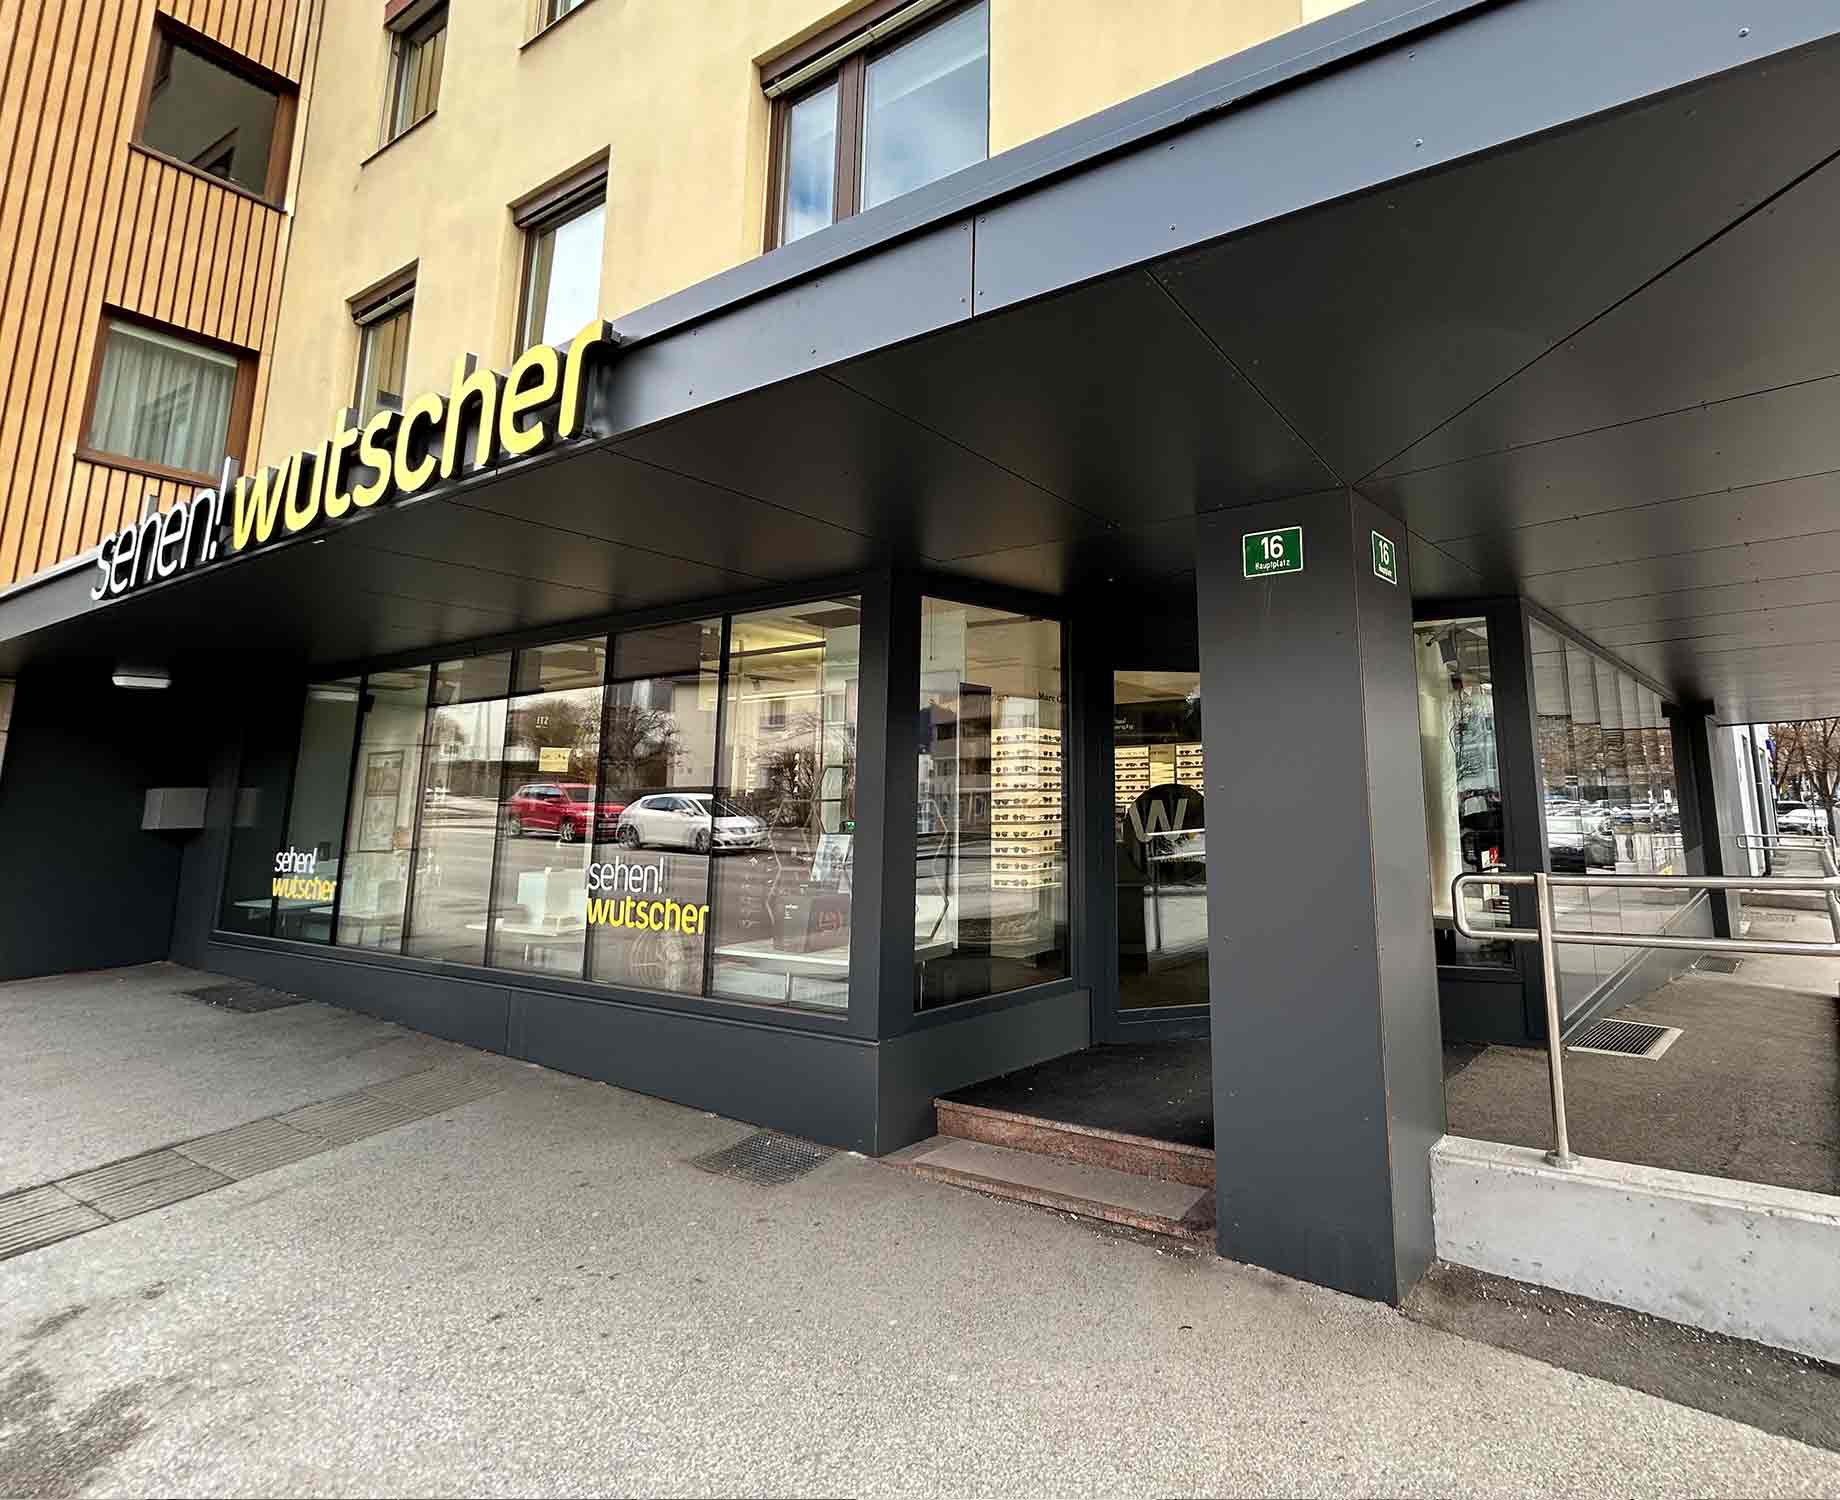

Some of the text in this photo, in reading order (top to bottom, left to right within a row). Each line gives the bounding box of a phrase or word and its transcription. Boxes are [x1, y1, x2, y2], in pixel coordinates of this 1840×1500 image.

[91, 319, 604, 600] sehen! wutscher
[1261, 535, 1284, 559] 16
[1379, 540, 1390, 565] 16
[1255, 559, 1291, 570] Hauptplatz
[274, 846, 318, 874] sehen!
[272, 875, 337, 901] wutscher
[588, 855, 664, 894] sehen!
[587, 896, 709, 935] wutscher
